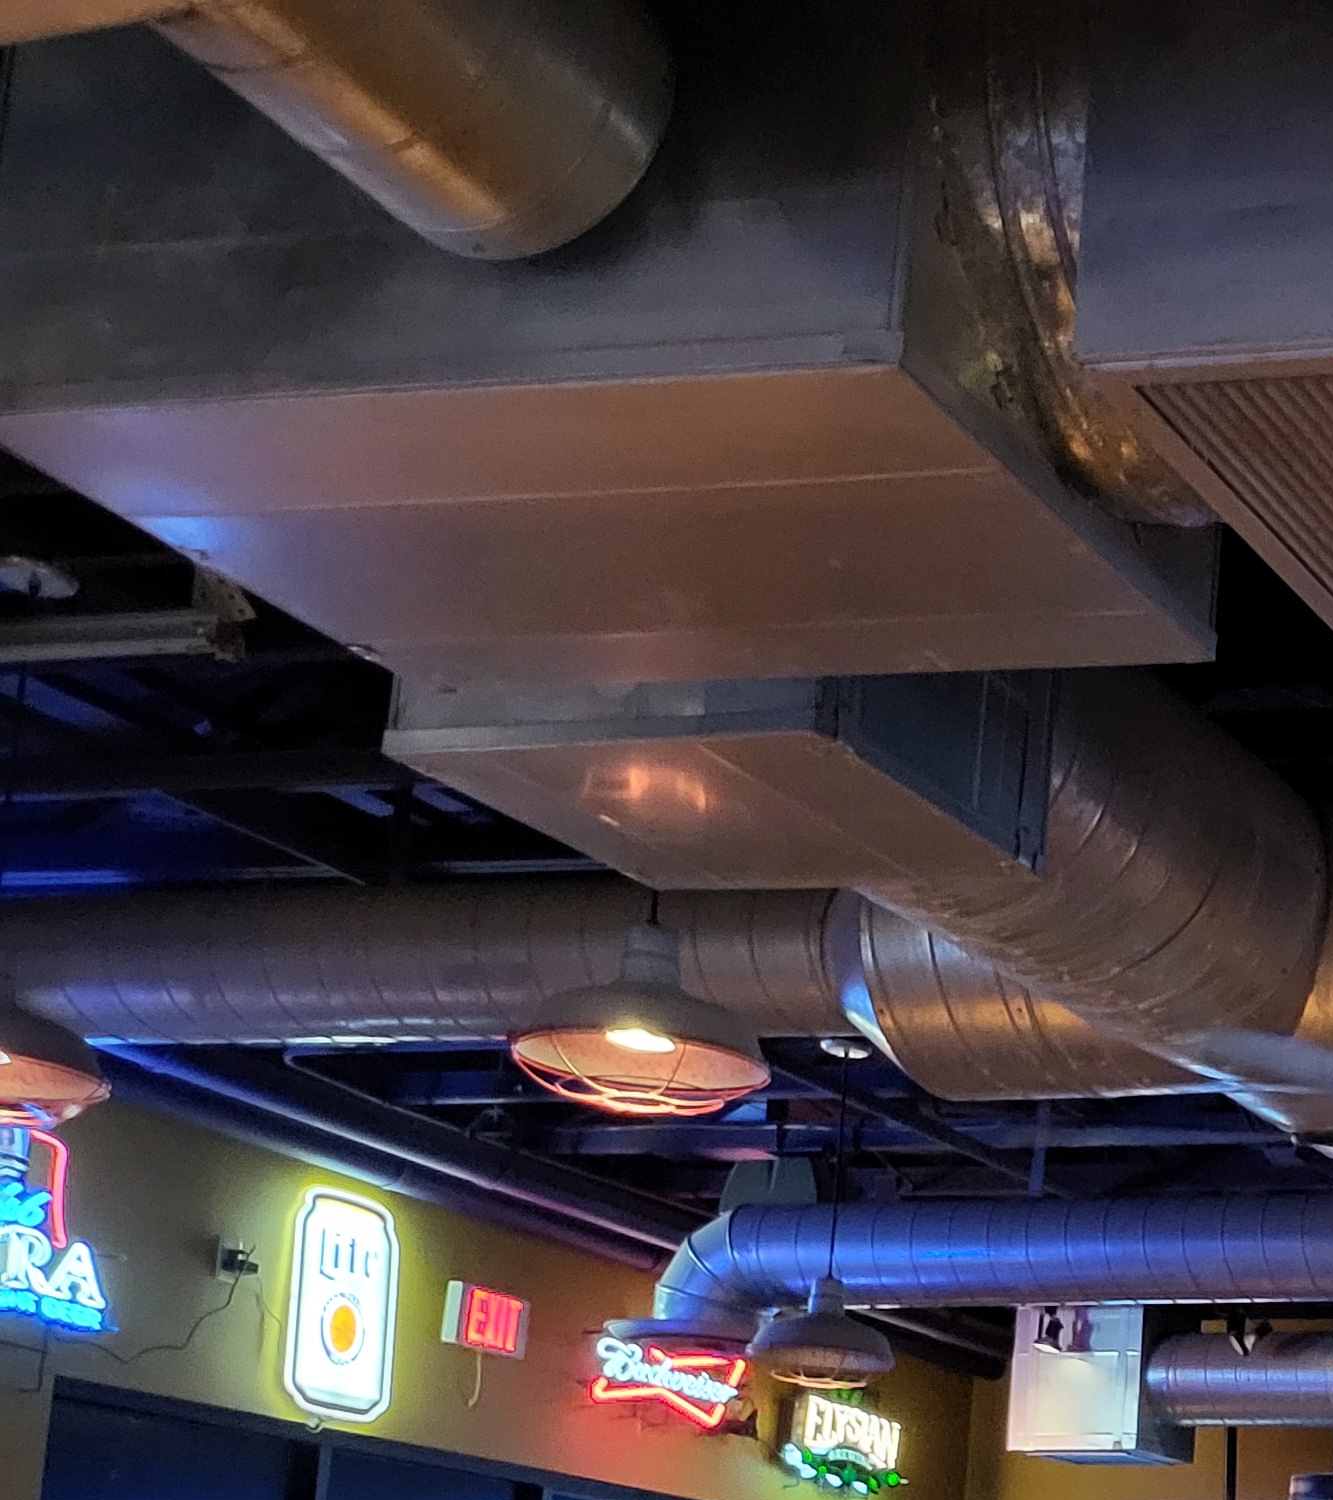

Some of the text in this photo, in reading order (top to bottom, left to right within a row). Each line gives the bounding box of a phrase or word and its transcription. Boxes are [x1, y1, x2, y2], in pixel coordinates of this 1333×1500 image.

[319, 1228, 378, 1281] Lite
[465, 1287, 525, 1353] EXIT
[597, 1338, 739, 1404] Budweiser
[804, 1394, 902, 1469] ELYSIAN
